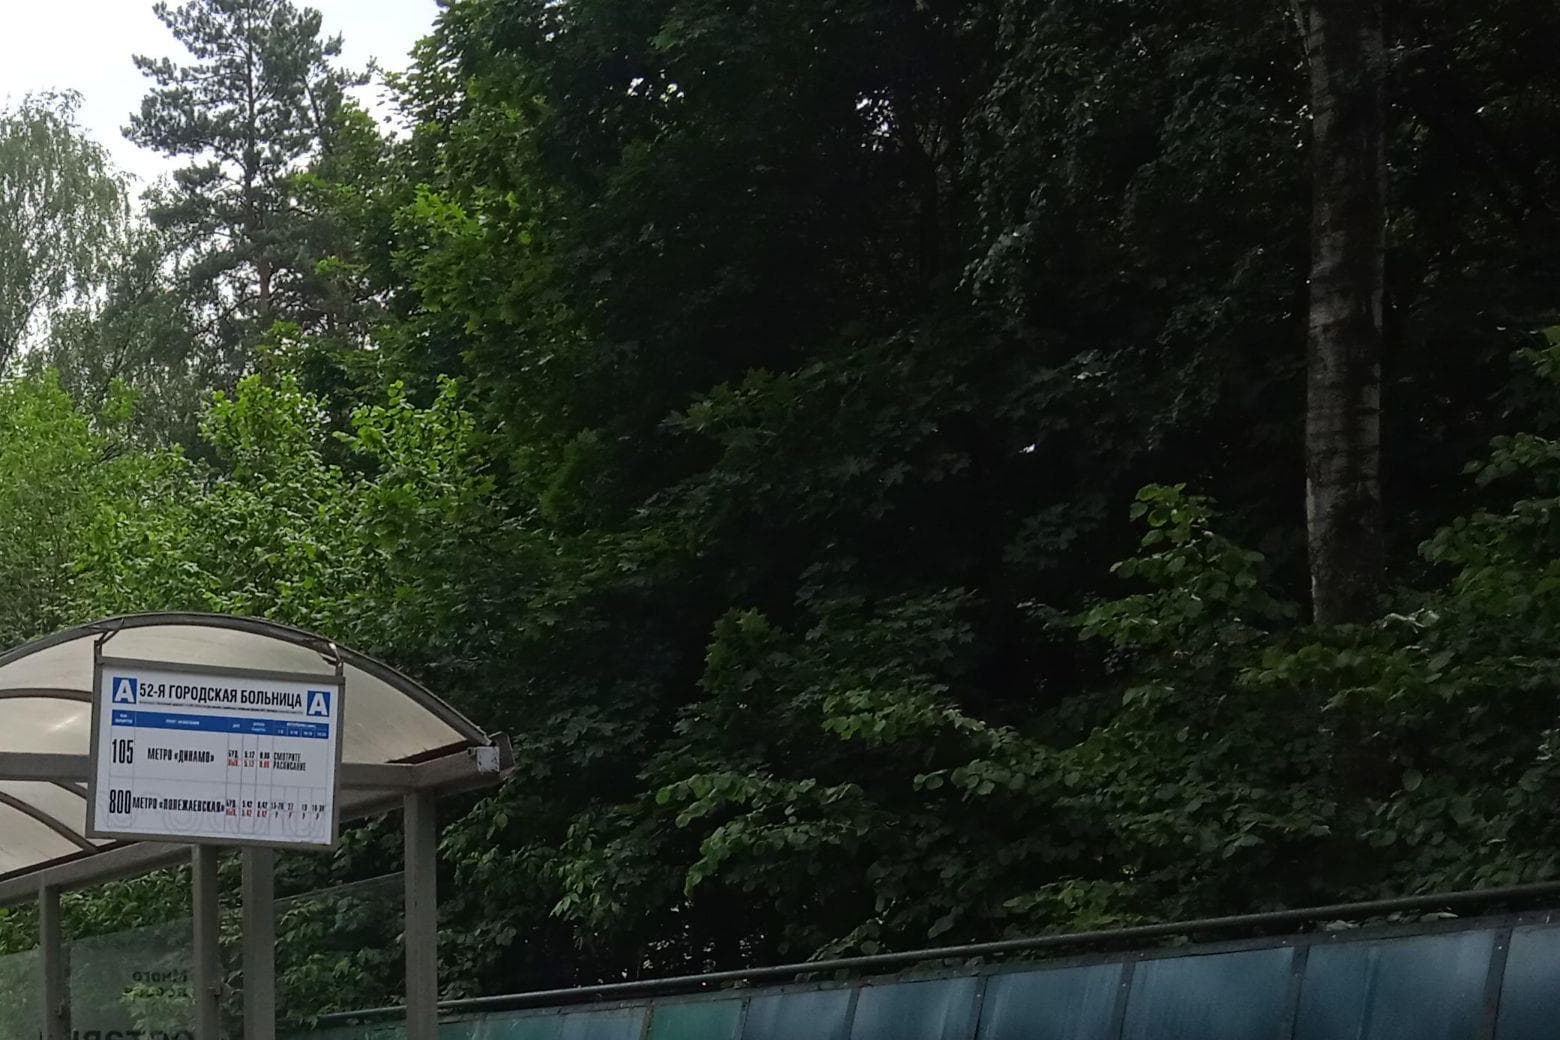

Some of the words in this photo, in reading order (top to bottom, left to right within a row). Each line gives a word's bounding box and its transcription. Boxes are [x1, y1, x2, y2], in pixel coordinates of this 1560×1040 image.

[139, 683, 166, 699] 52-Я
[169, 684, 238, 704] ГОРОДСКАЯ
[240, 688, 303, 709] БОЛЬНИЦА
[111, 738, 134, 764] 105
[147, 748, 173, 761] МЕТРО
[109, 789, 132, 815] 800
[132, 796, 158, 810] МЕТРО
